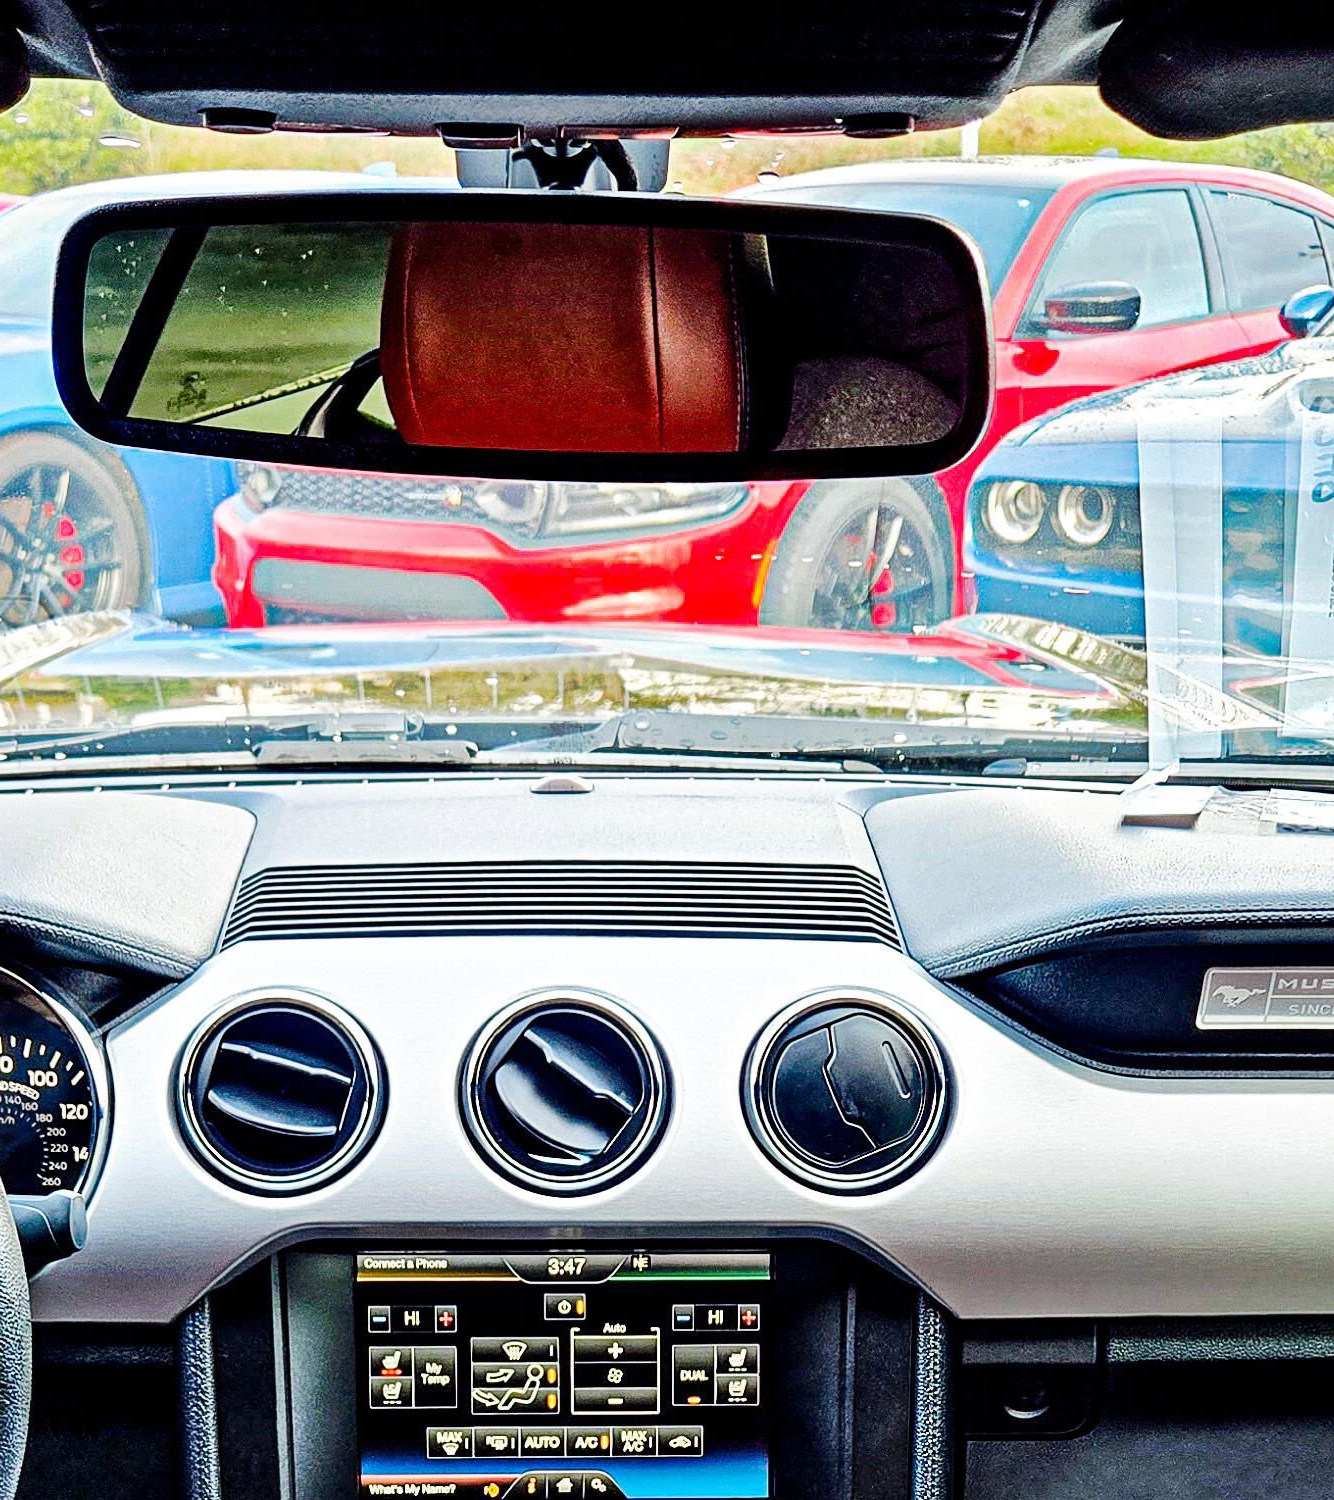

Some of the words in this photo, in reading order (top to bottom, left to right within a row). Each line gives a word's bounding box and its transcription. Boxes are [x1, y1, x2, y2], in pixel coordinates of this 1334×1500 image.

[27, 1069, 58, 1087] 100
[8, 1081, 40, 1100] SPEED
[4, 1095, 22, 1105] 140
[21, 1102, 38, 1111] 160
[59, 1103, 88, 1120] 120
[35, 1113, 53, 1122] 180
[47, 1127, 66, 1136] 200
[50, 1144, 68, 1152] 220
[49, 1161, 67, 1170] 240
[42, 1177, 61, 1186] 260
[364, 1258, 405, 1269] Connect
[416, 1257, 448, 1269] Phone
[547, 1257, 587, 1275] 3:47
[404, 1310, 420, 1326] HI
[708, 1309, 724, 1325] HI
[603, 1322, 626, 1334] Auto
[425, 1363, 442, 1375] My
[420, 1373, 450, 1386] Temp
[680, 1370, 709, 1382] DUAL
[436, 1431, 462, 1443] MAX
[524, 1435, 560, 1449] AUTO
[575, 1436, 598, 1449] A/C
[621, 1431, 647, 1442] MAX
[622, 1440, 644, 1452] A/C
[369, 1484, 403, 1495] What's
[404, 1485, 420, 1497] My
[421, 1483, 456, 1495] Name?
